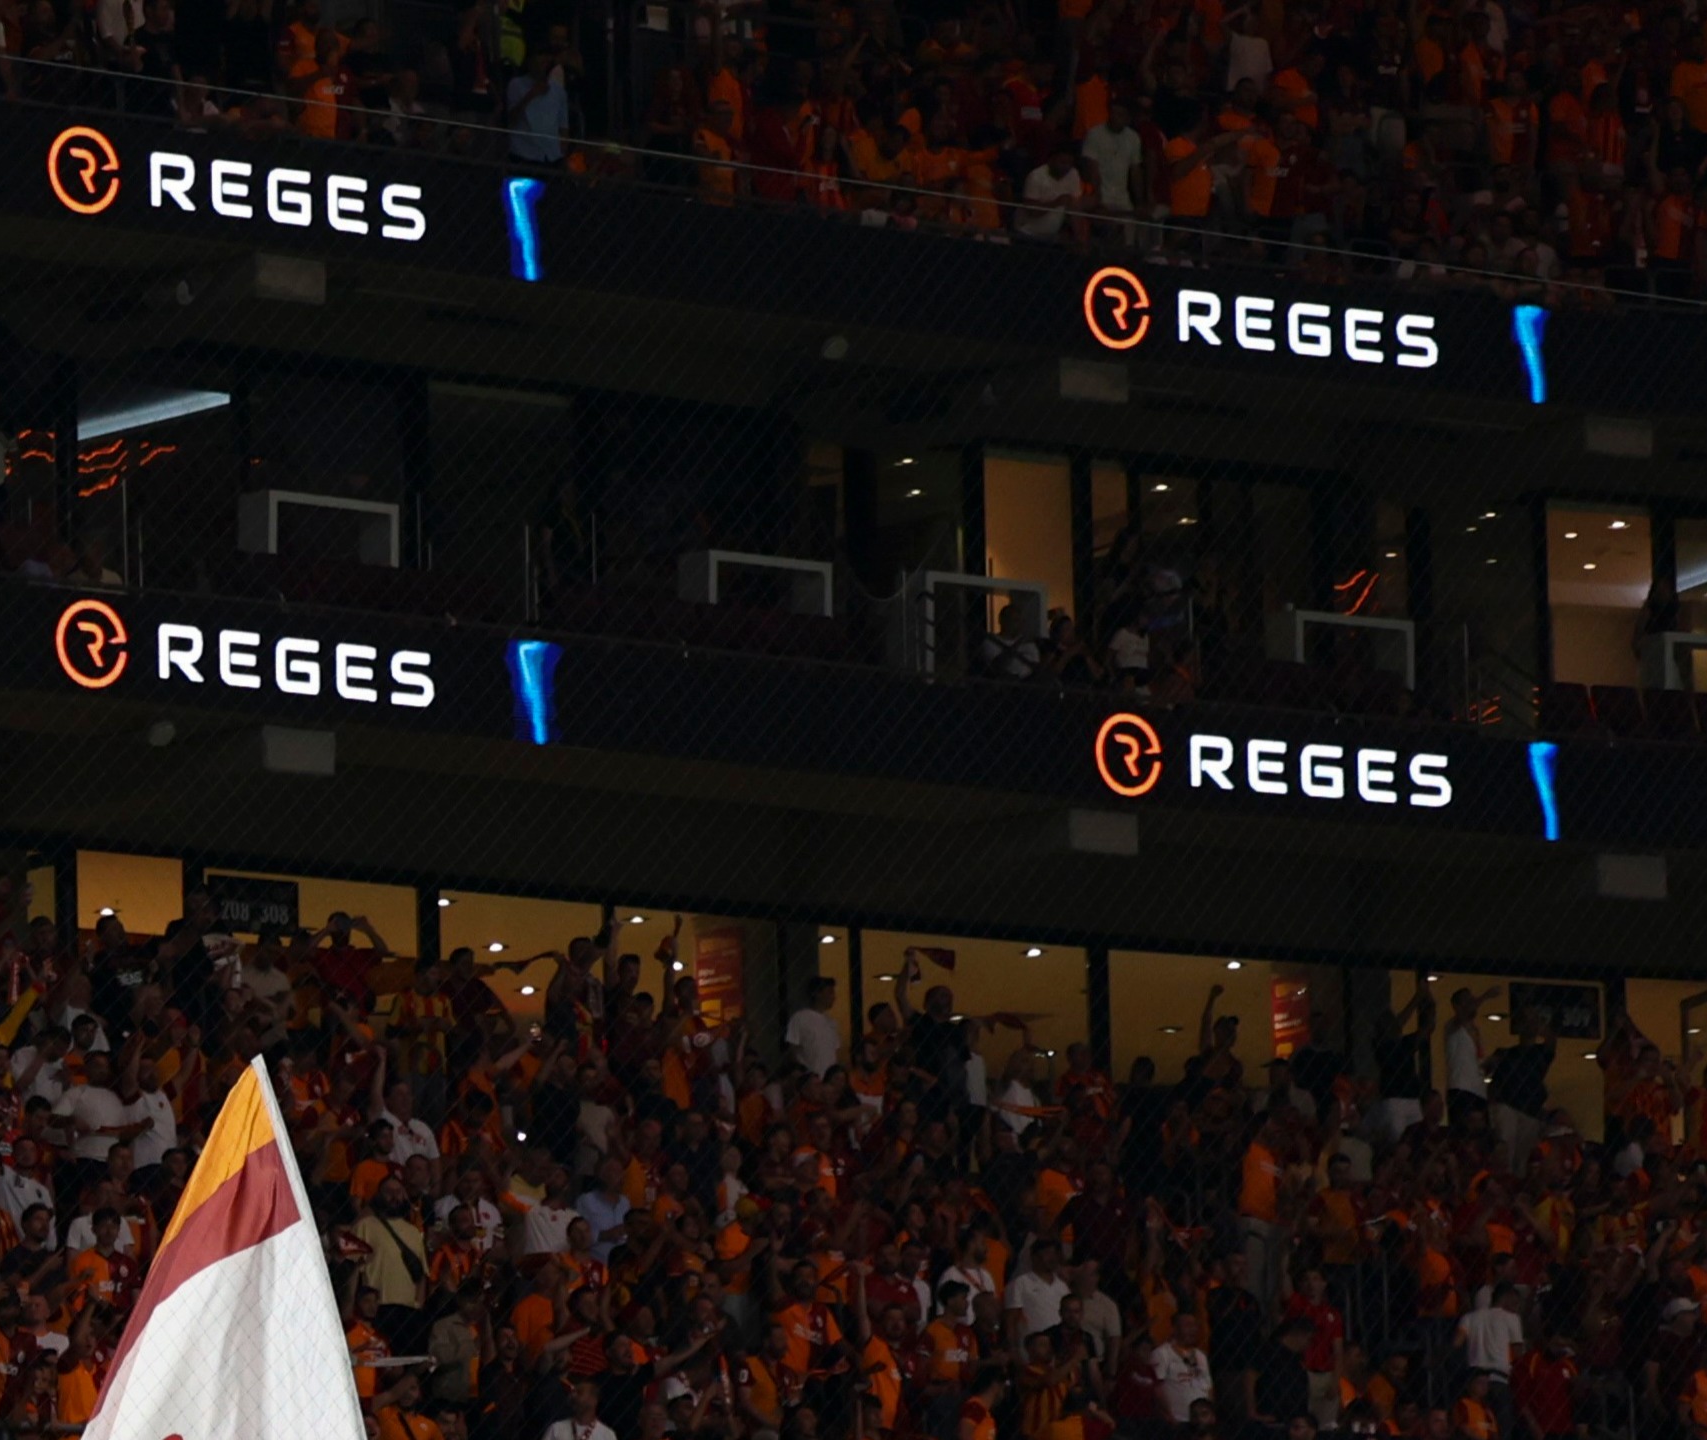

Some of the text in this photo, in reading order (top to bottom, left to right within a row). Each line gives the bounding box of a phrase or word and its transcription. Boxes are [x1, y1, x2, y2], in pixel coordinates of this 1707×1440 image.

[150, 150, 427, 241] REGES
[1178, 288, 1439, 369] REGES
[158, 622, 436, 708] REGES
[1190, 733, 1453, 808] REGES
